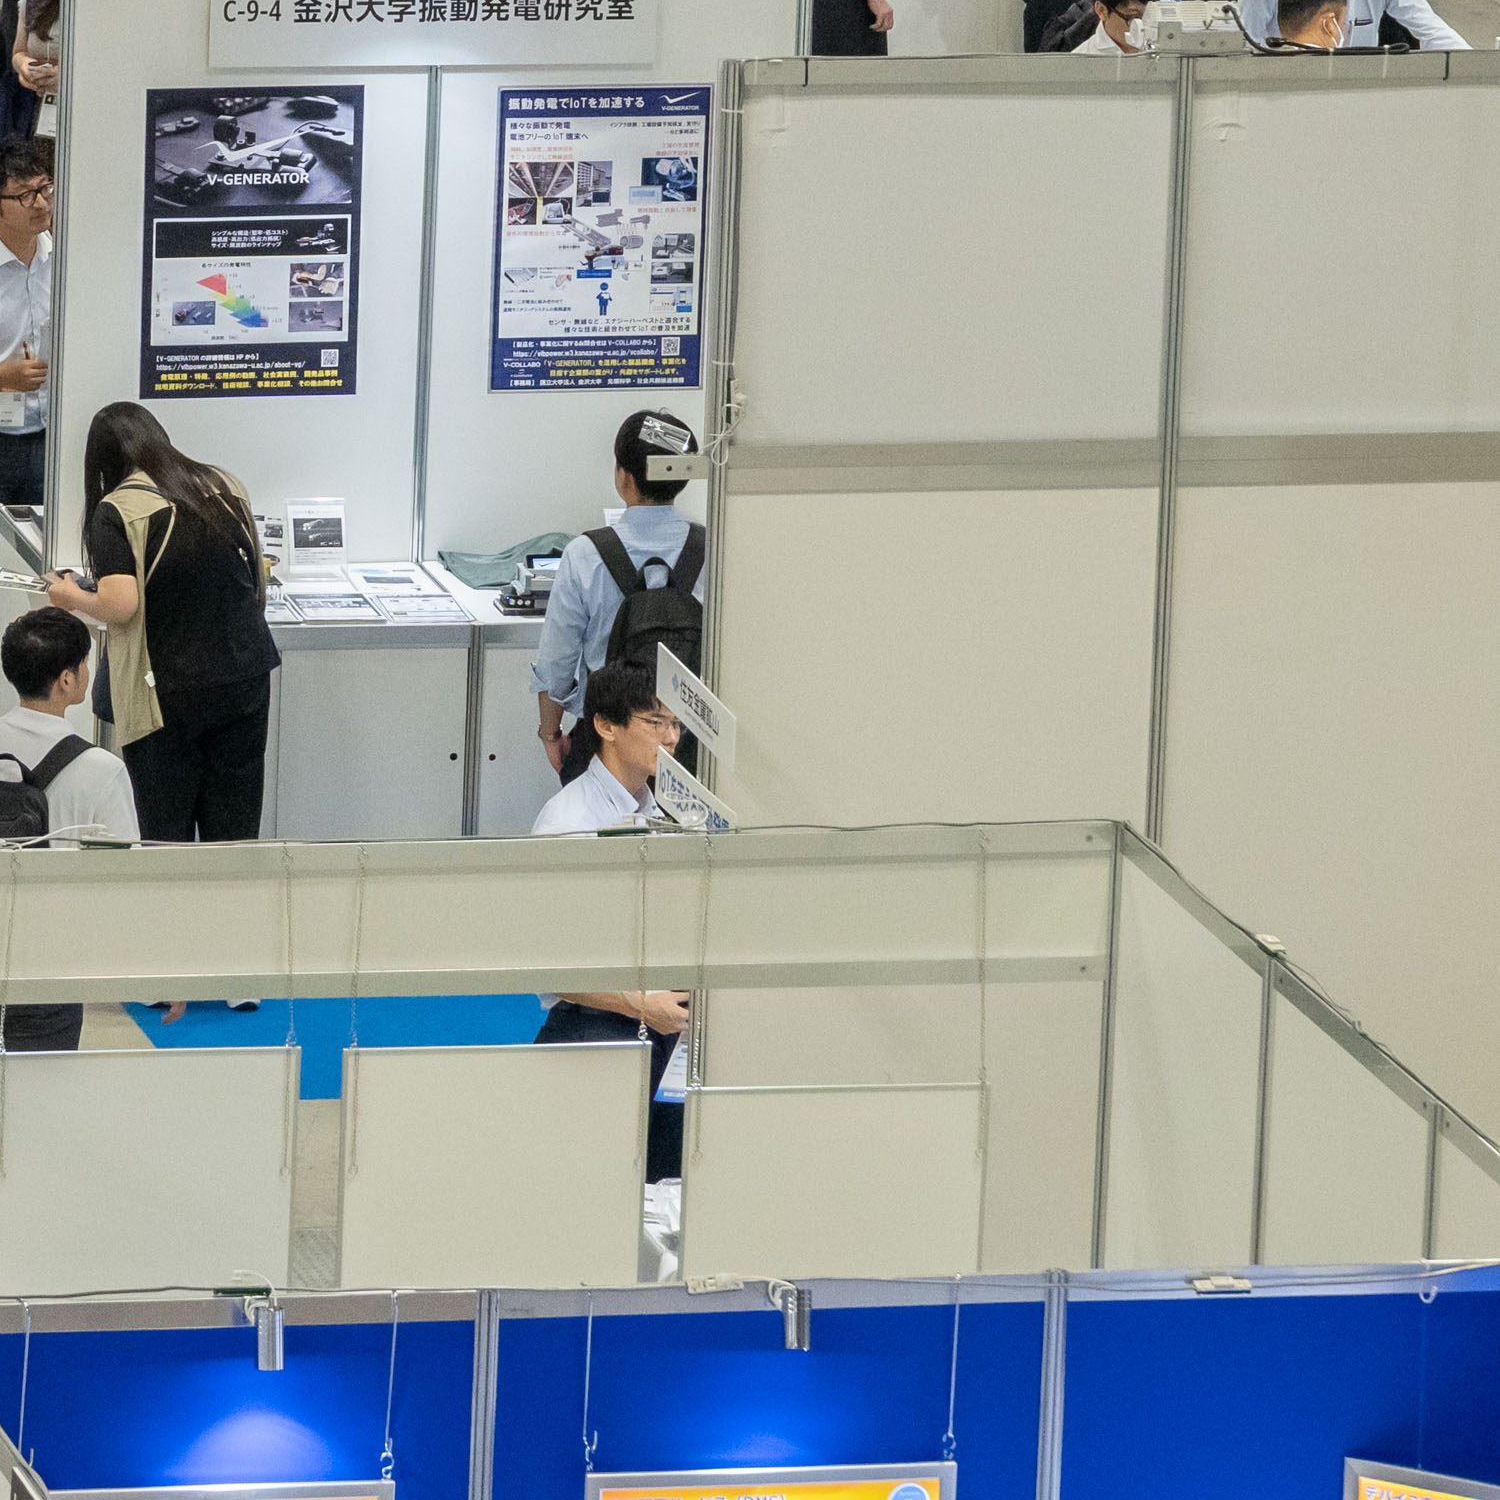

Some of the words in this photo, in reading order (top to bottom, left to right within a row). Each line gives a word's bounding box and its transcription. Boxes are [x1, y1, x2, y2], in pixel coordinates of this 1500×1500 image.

[223, 0, 281, 21] C-9-4
[508, 97, 645, 111] 振動発電でIoTを加速する
[510, 122, 571, 130] 様々な振動で発電
[207, 172, 310, 186] V-GENERATOR
